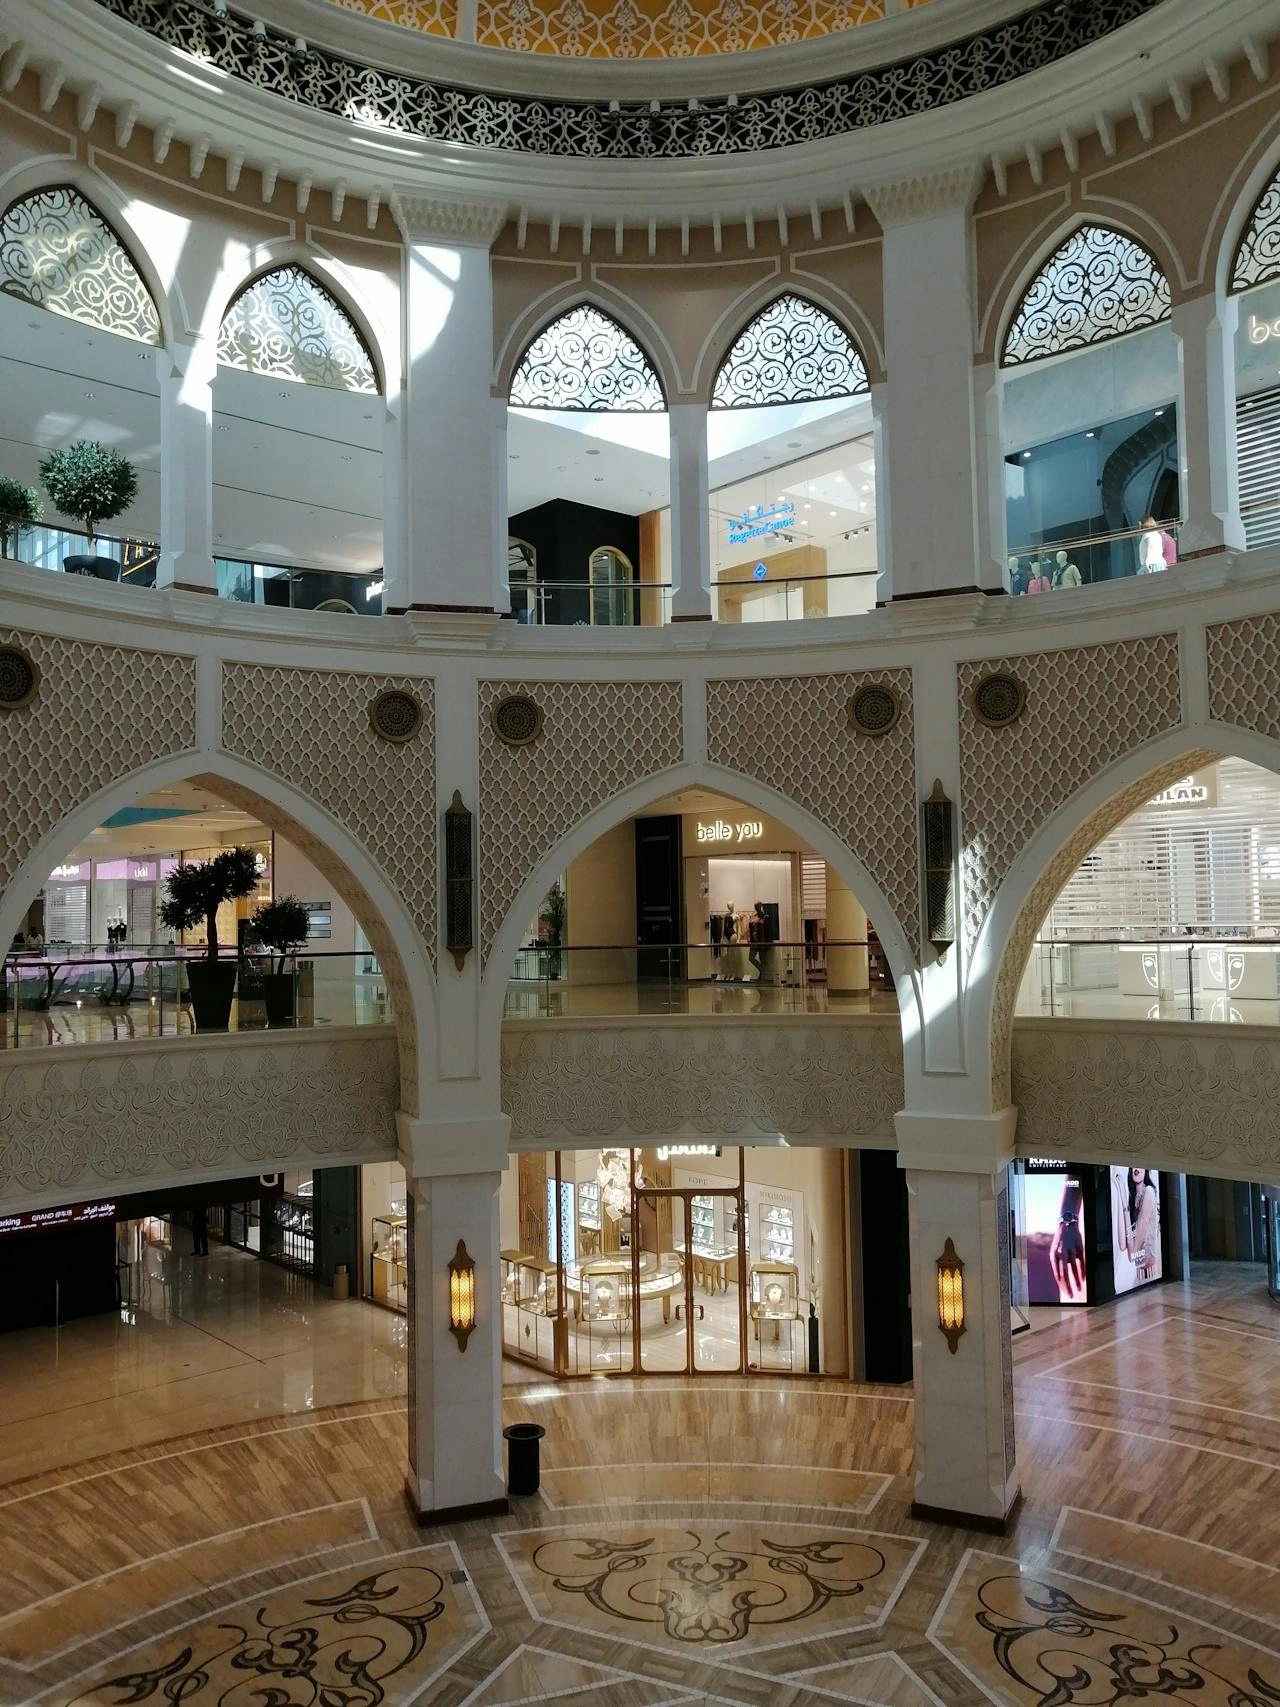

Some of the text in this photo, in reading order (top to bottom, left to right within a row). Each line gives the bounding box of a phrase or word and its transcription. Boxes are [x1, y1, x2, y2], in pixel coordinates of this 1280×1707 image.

[1151, 786, 1207, 803] ILAN
[697, 820, 762, 842] belle you
[31, 1212, 54, 1222] GRAND
